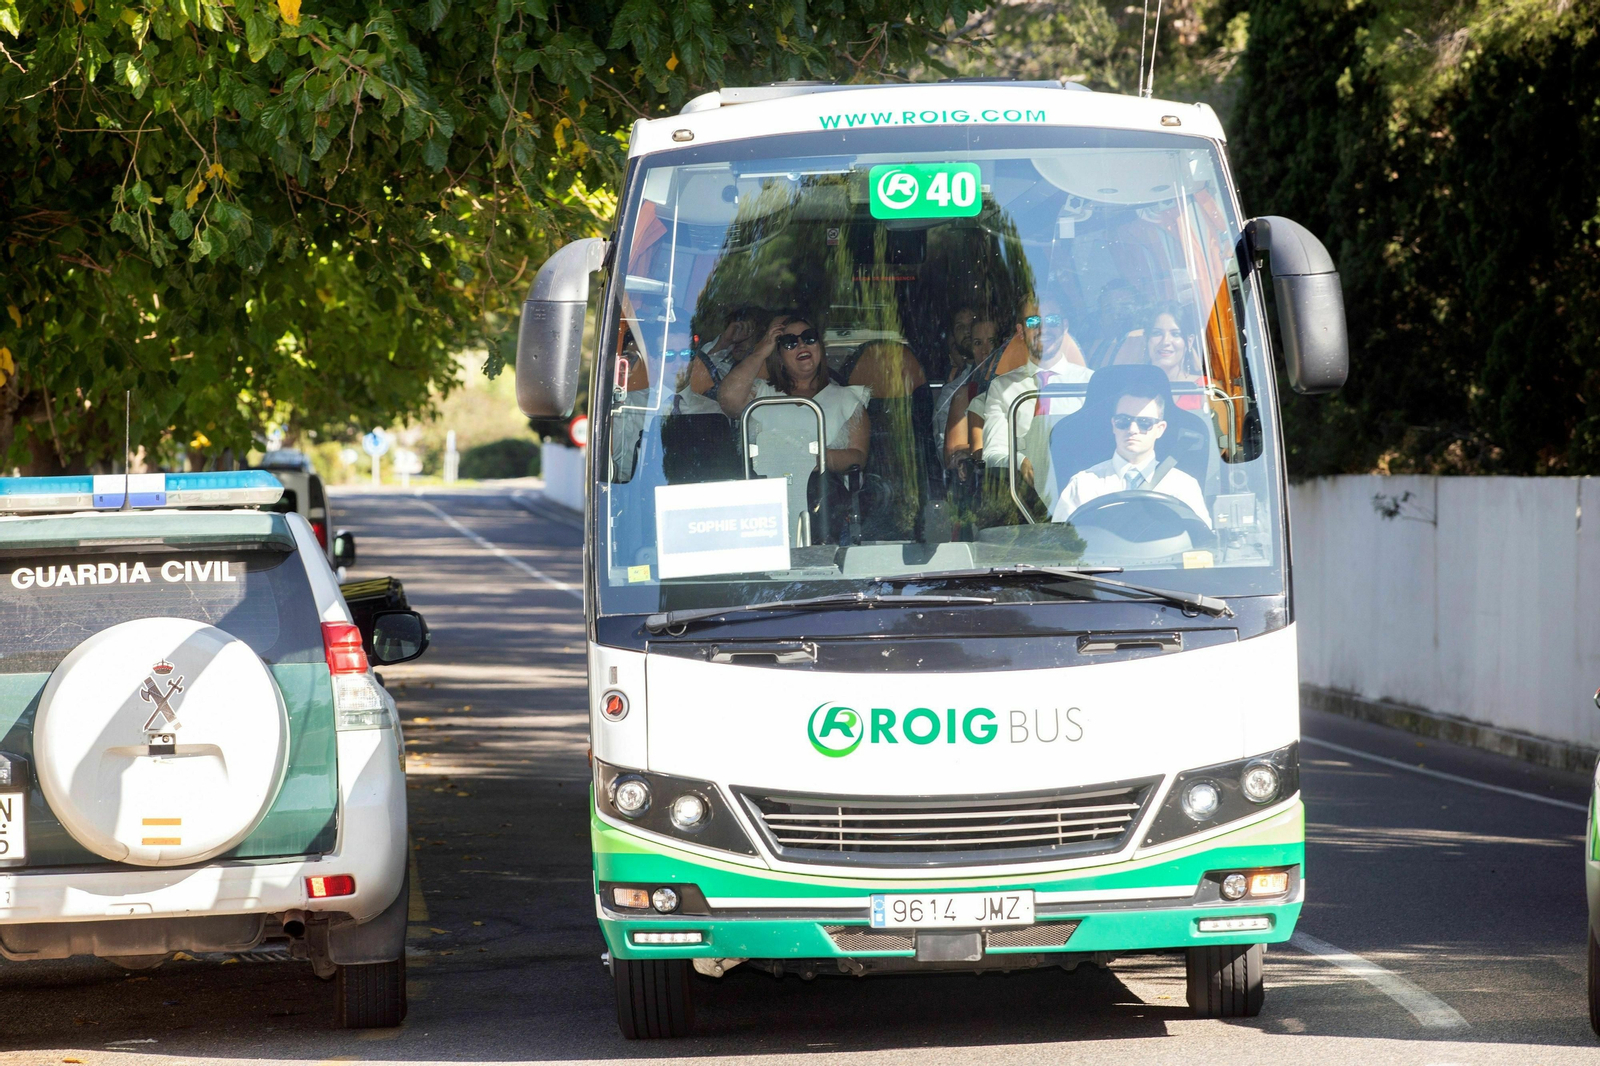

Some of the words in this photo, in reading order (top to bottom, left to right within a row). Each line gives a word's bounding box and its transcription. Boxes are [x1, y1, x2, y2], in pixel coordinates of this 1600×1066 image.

[818, 109, 1046, 129] WWW.ROIG.COM
[926, 171, 976, 207] 40
[688, 518, 738, 534] SOPHIE
[740, 516, 778, 530] KORS
[10, 561, 152, 590] GUARDIA
[160, 560, 237, 583] CIVIL
[870, 707, 999, 745] ROIG
[1009, 706, 1084, 744] BUS
[892, 898, 957, 923] 9614
[974, 896, 1020, 921] JMZ
